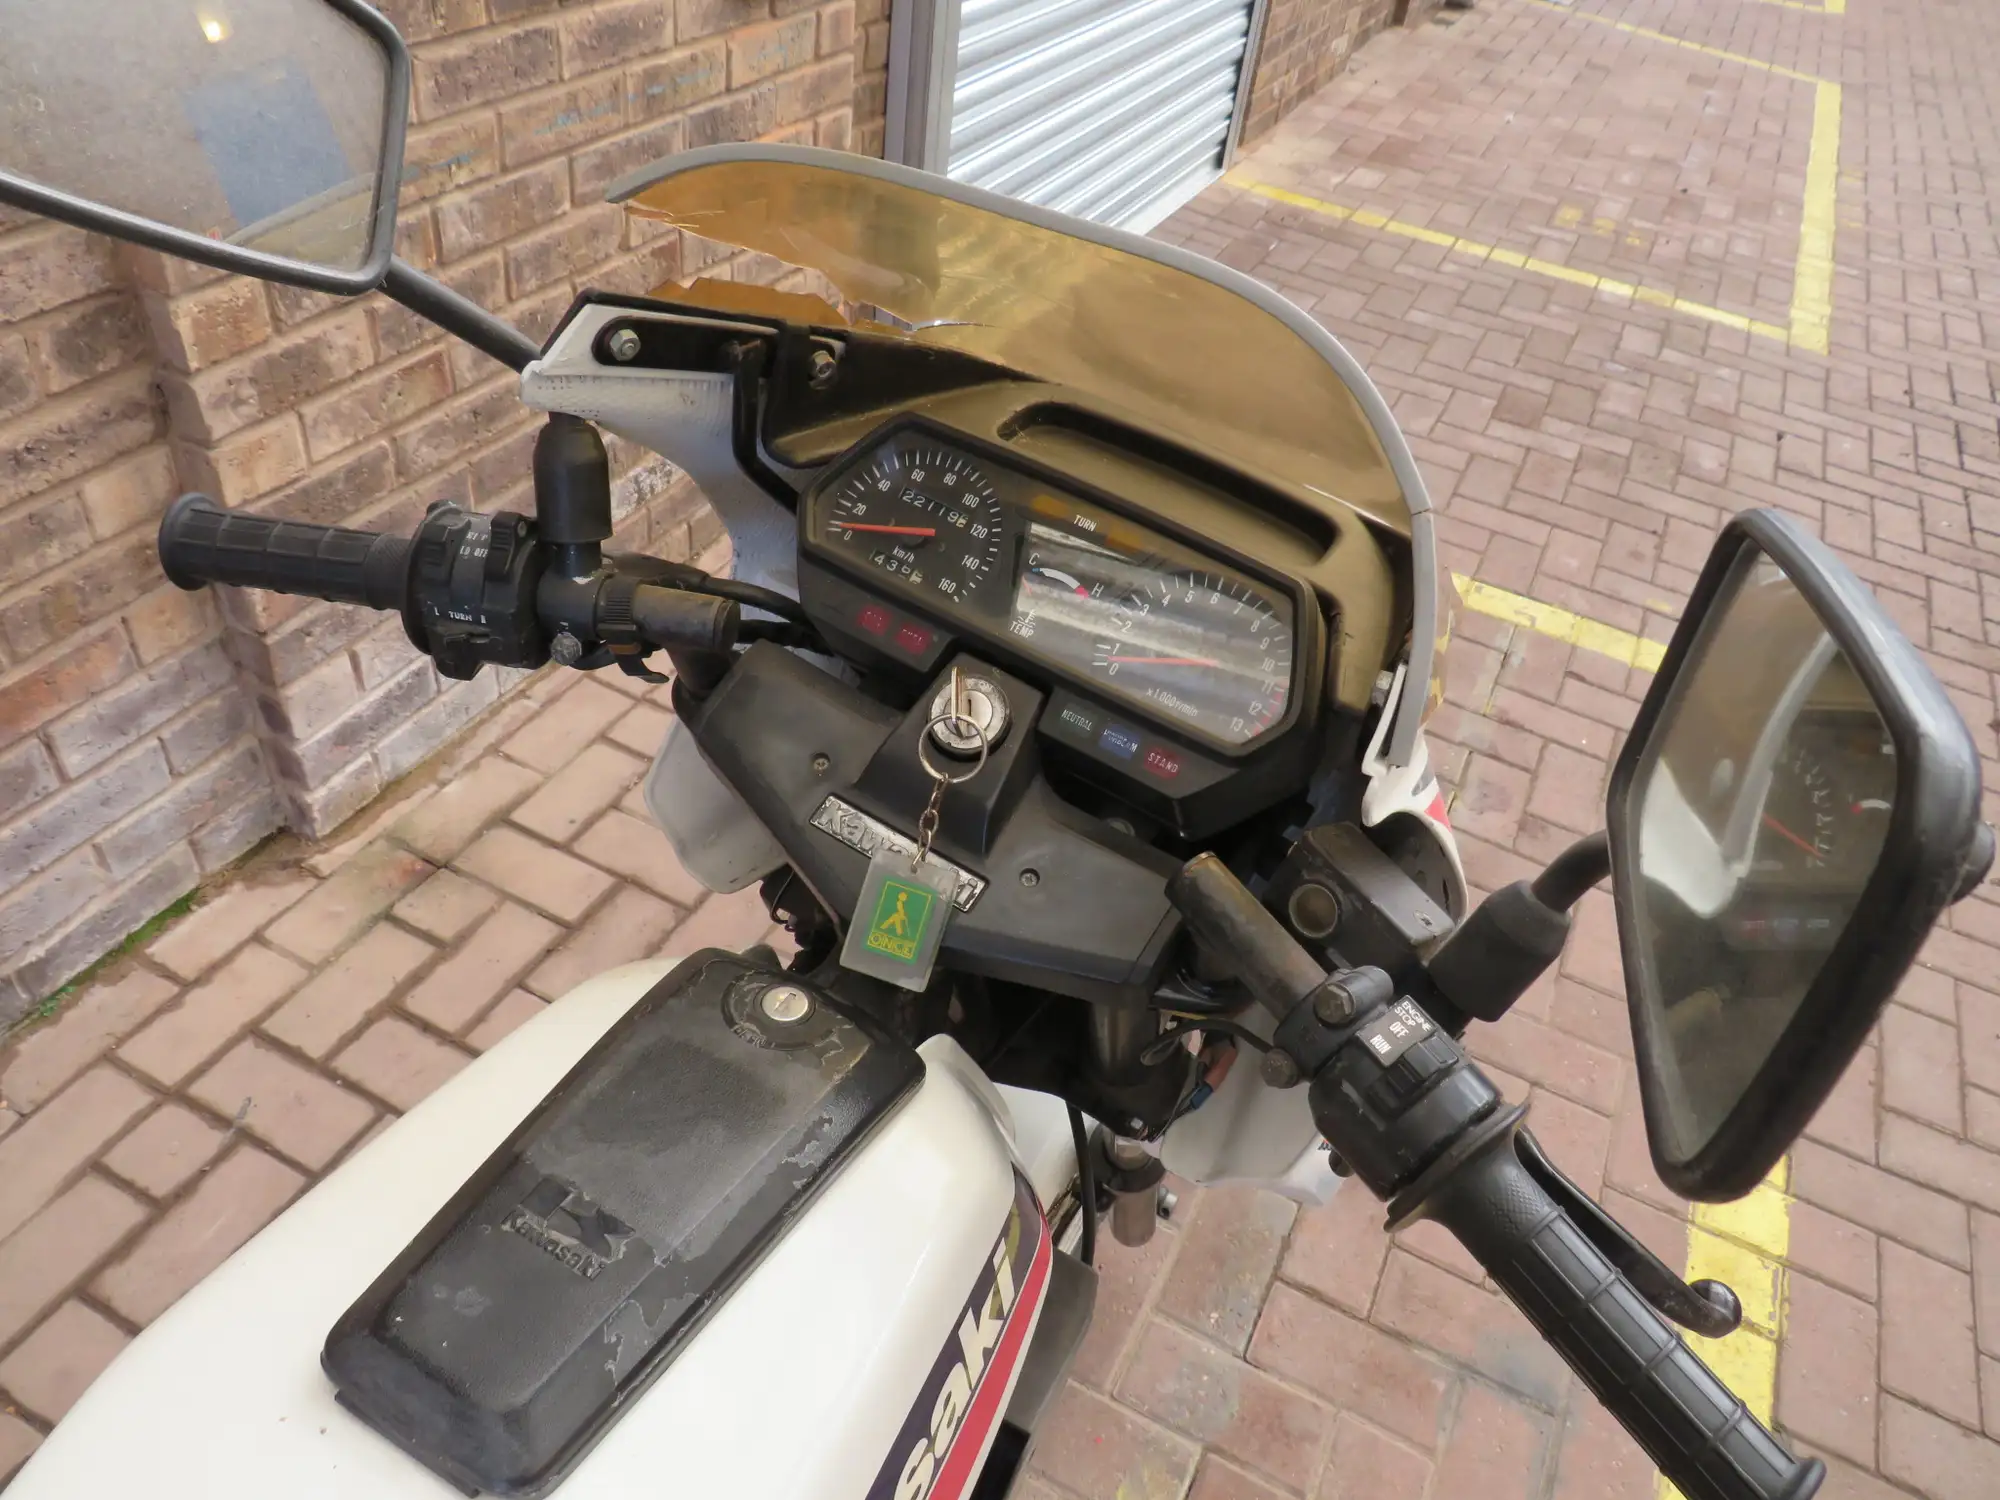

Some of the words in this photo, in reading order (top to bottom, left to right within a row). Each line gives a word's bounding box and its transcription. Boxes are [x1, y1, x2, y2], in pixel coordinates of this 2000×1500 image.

[911, 468, 925, 482] 60
[943, 472, 957, 486] 80
[877, 479, 891, 492] 40
[962, 492, 980, 508] 100
[853, 502, 867, 516] 20
[1073, 514, 1097, 532] TURN
[843, 530, 853, 541] 0
[971, 523, 988, 539] 120
[892, 545, 915, 563] km/h
[1028, 552, 1040, 566] C
[962, 554, 980, 570] 140
[938, 577, 957, 594] 160
[1091, 582, 1104, 598] H
[1162, 594, 1171, 607] 4
[1184, 590, 1195, 603] 5
[1210, 592, 1220, 605] 6
[434, 607, 440, 616] L
[448, 610, 473, 622] TURN
[1140, 603, 1150, 616] 3
[1233, 602, 1243, 615] 7
[1009, 621, 1035, 639] TEMP
[1121, 621, 1132, 633] 2
[1251, 620, 1260, 632] 8
[1112, 643, 1121, 655] 1
[1259, 636, 1270, 650] 9
[1109, 662, 1120, 676] 0
[1261, 657, 1275, 672] 10
[1260, 679, 1275, 694] 11
[1248, 700, 1263, 716] 12
[1061, 709, 1093, 731] NEUTRAL
[1229, 717, 1244, 732] 13
[1147, 752, 1179, 773] STAND
[869, 932, 915, 958] ONCE
[1395, 1006, 1416, 1026] STOP
[1401, 1001, 1432, 1032] ENGINE
[1389, 1021, 1409, 1038] OFF
[1370, 1034, 1392, 1054] RUN
[500, 1210, 606, 1281] Kawasaki
